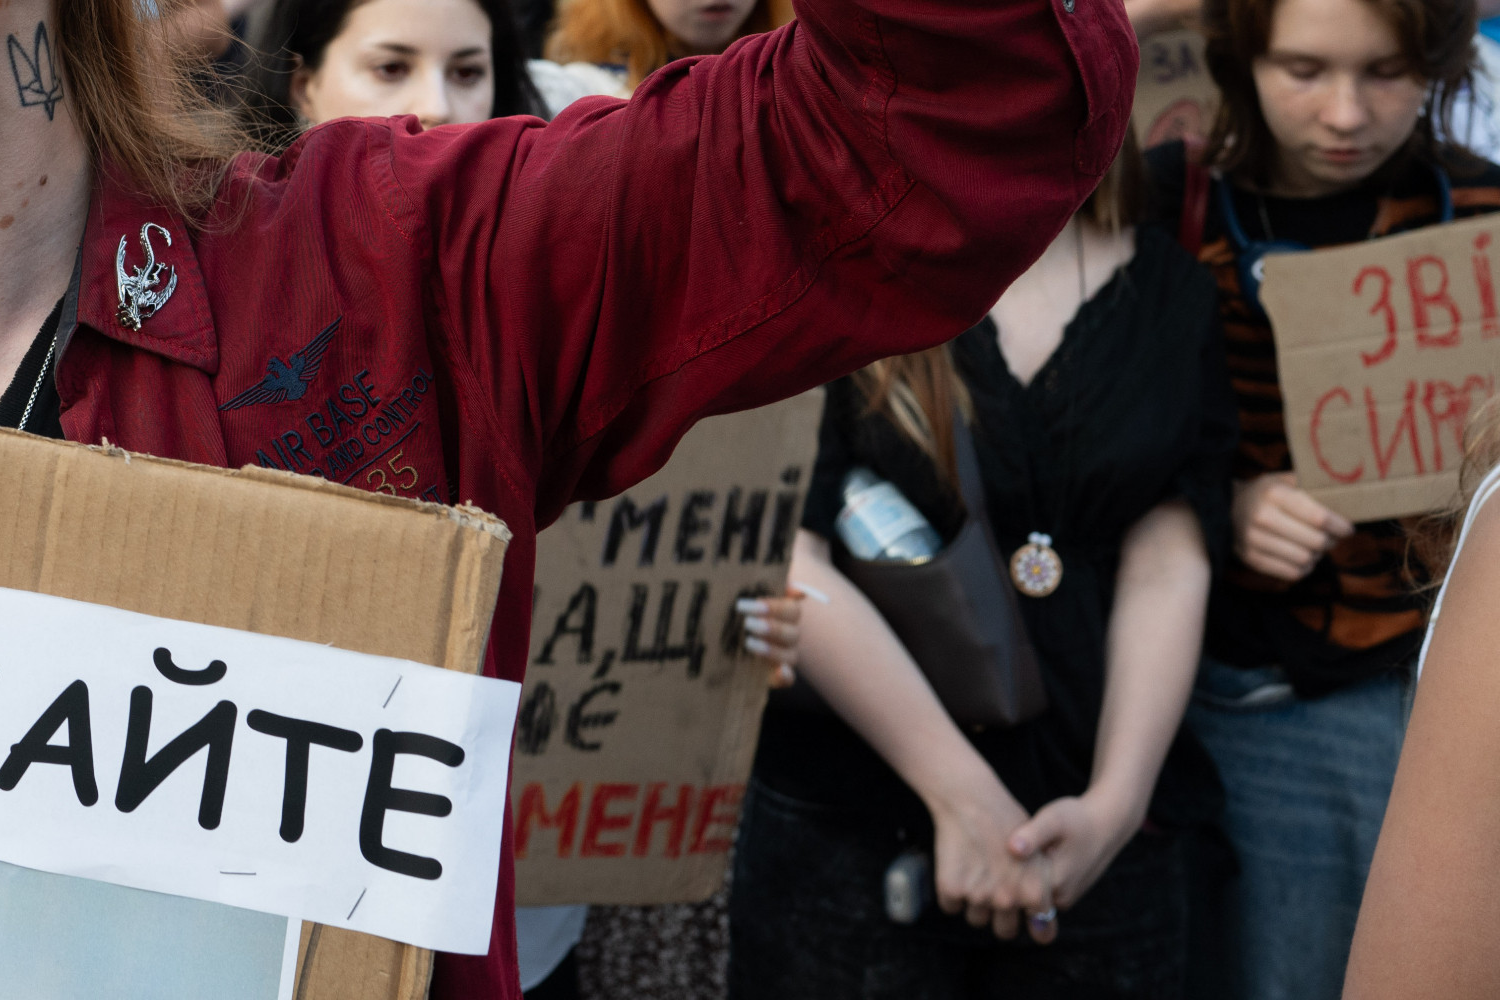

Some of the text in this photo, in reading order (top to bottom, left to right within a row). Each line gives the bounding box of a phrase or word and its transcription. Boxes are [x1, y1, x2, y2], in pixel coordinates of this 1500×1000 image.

[255, 368, 382, 473] AIR BASE
[325, 366, 436, 479] AND CONTROL
[366, 449, 419, 496] 35
